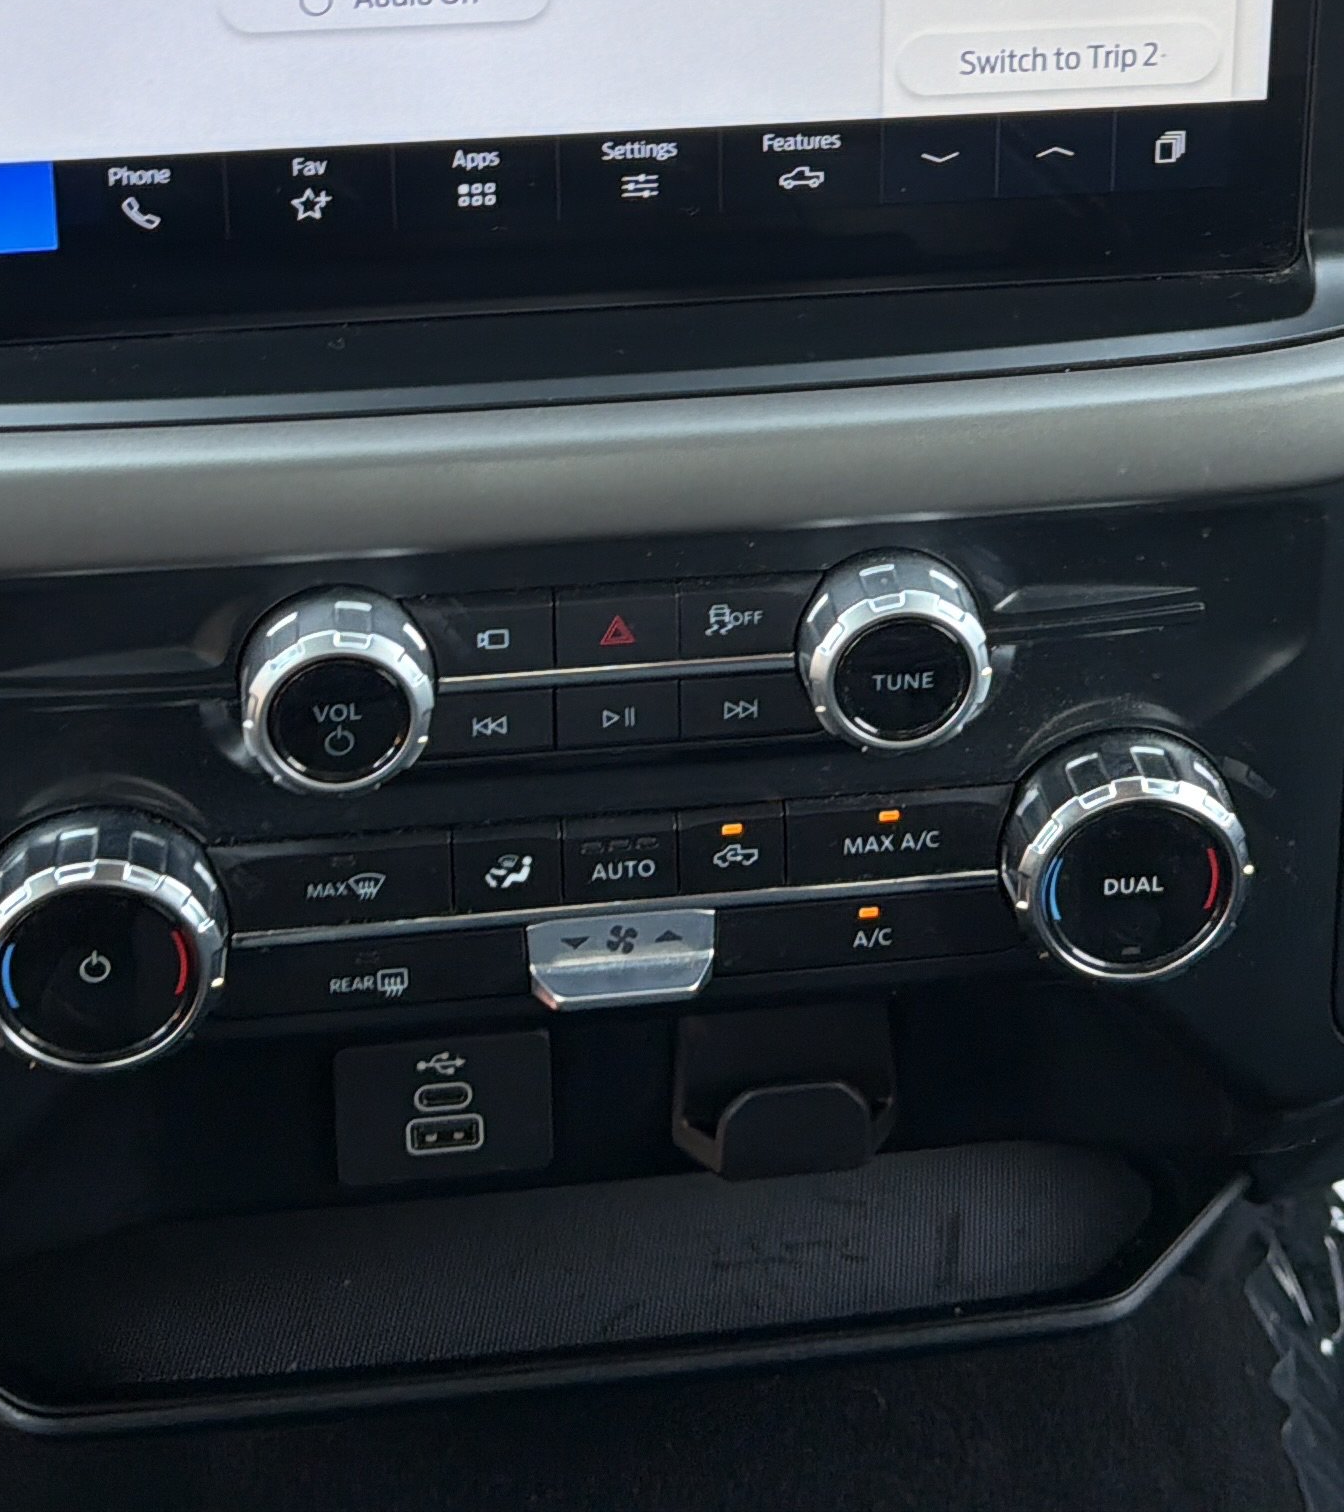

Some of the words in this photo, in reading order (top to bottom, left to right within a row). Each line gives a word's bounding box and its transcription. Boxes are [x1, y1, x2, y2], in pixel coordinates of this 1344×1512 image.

[960, 47, 1046, 75] Switch
[1053, 48, 1080, 70] to
[1087, 44, 1137, 72] Trip
[1143, 42, 1158, 66] 2
[602, 141, 677, 160] Settings
[763, 134, 841, 152] Features
[292, 158, 327, 176] Fav
[452, 150, 500, 170] Apps
[108, 166, 171, 186] Phone
[732, 610, 763, 626] OFF
[872, 672, 933, 690] TUNE
[313, 703, 362, 723] VOL
[844, 834, 894, 854] MAX
[901, 831, 939, 850] A/C
[592, 859, 655, 881] AUTO
[307, 882, 347, 898] MAX
[1104, 876, 1163, 895] DUAL
[853, 928, 891, 947] A/C
[330, 976, 374, 993] REAR
